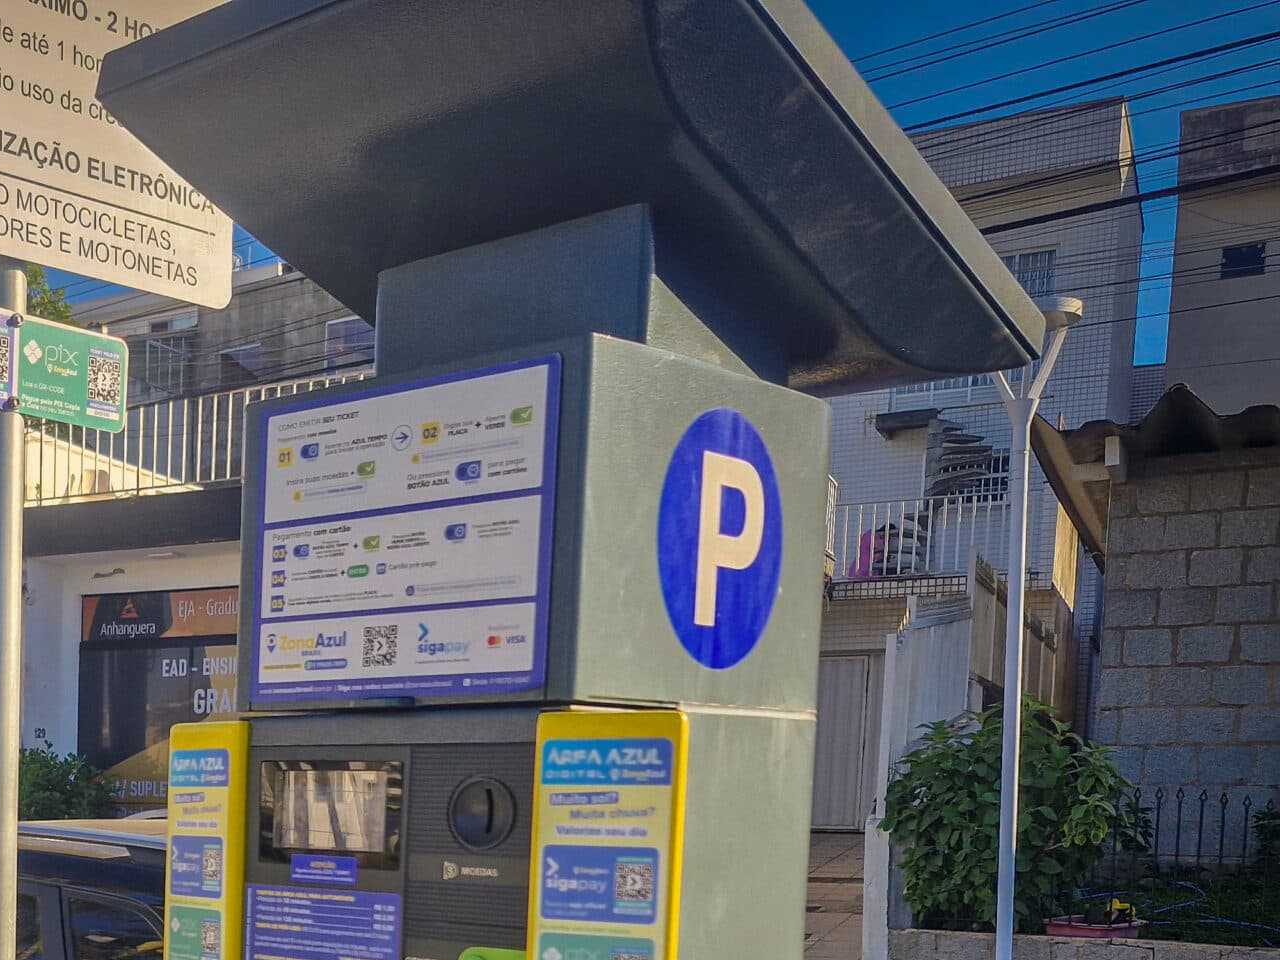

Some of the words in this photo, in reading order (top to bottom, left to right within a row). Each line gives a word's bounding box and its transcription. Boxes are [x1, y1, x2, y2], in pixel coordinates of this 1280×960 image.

[107, 11, 118, 33] 2
[124, 16, 158, 40] HO
[20, 31, 49, 55] até
[57, 40, 64, 61] 1
[21, 80, 54, 105] uso
[60, 89, 82, 114] da
[88, 103, 125, 127] cre
[87, 157, 216, 215] ELETRÔNICA
[16, 188, 177, 256] MOTOCICLETAS,
[59, 231, 72, 254] E
[78, 236, 199, 287] MOTONETAS
[45, 344, 80, 367] pix
[322, 415, 336, 425] SEU
[336, 411, 360, 422] TICKET
[351, 437, 366, 446] AZUL
[367, 433, 388, 443] TEMPO
[422, 427, 438, 440] 02
[279, 451, 292, 463] 01
[313, 528, 327, 537] com
[328, 524, 351, 535] cartão
[694, 450, 765, 627] P
[178, 600, 196, 622] EJA
[100, 621, 156, 639] Anhanguera
[505, 635, 526, 644] VISA
[279, 630, 347, 651] ZonaAzul
[417, 639, 470, 656] sigapay
[162, 658, 188, 678] EAD
[34, 727, 46, 739] 129
[199, 757, 225, 771] AZUL
[547, 746, 603, 766] ÁREA
[605, 748, 663, 765] AZUL
[460, 866, 499, 878] MOEDAS
[545, 874, 608, 894] sigapay
